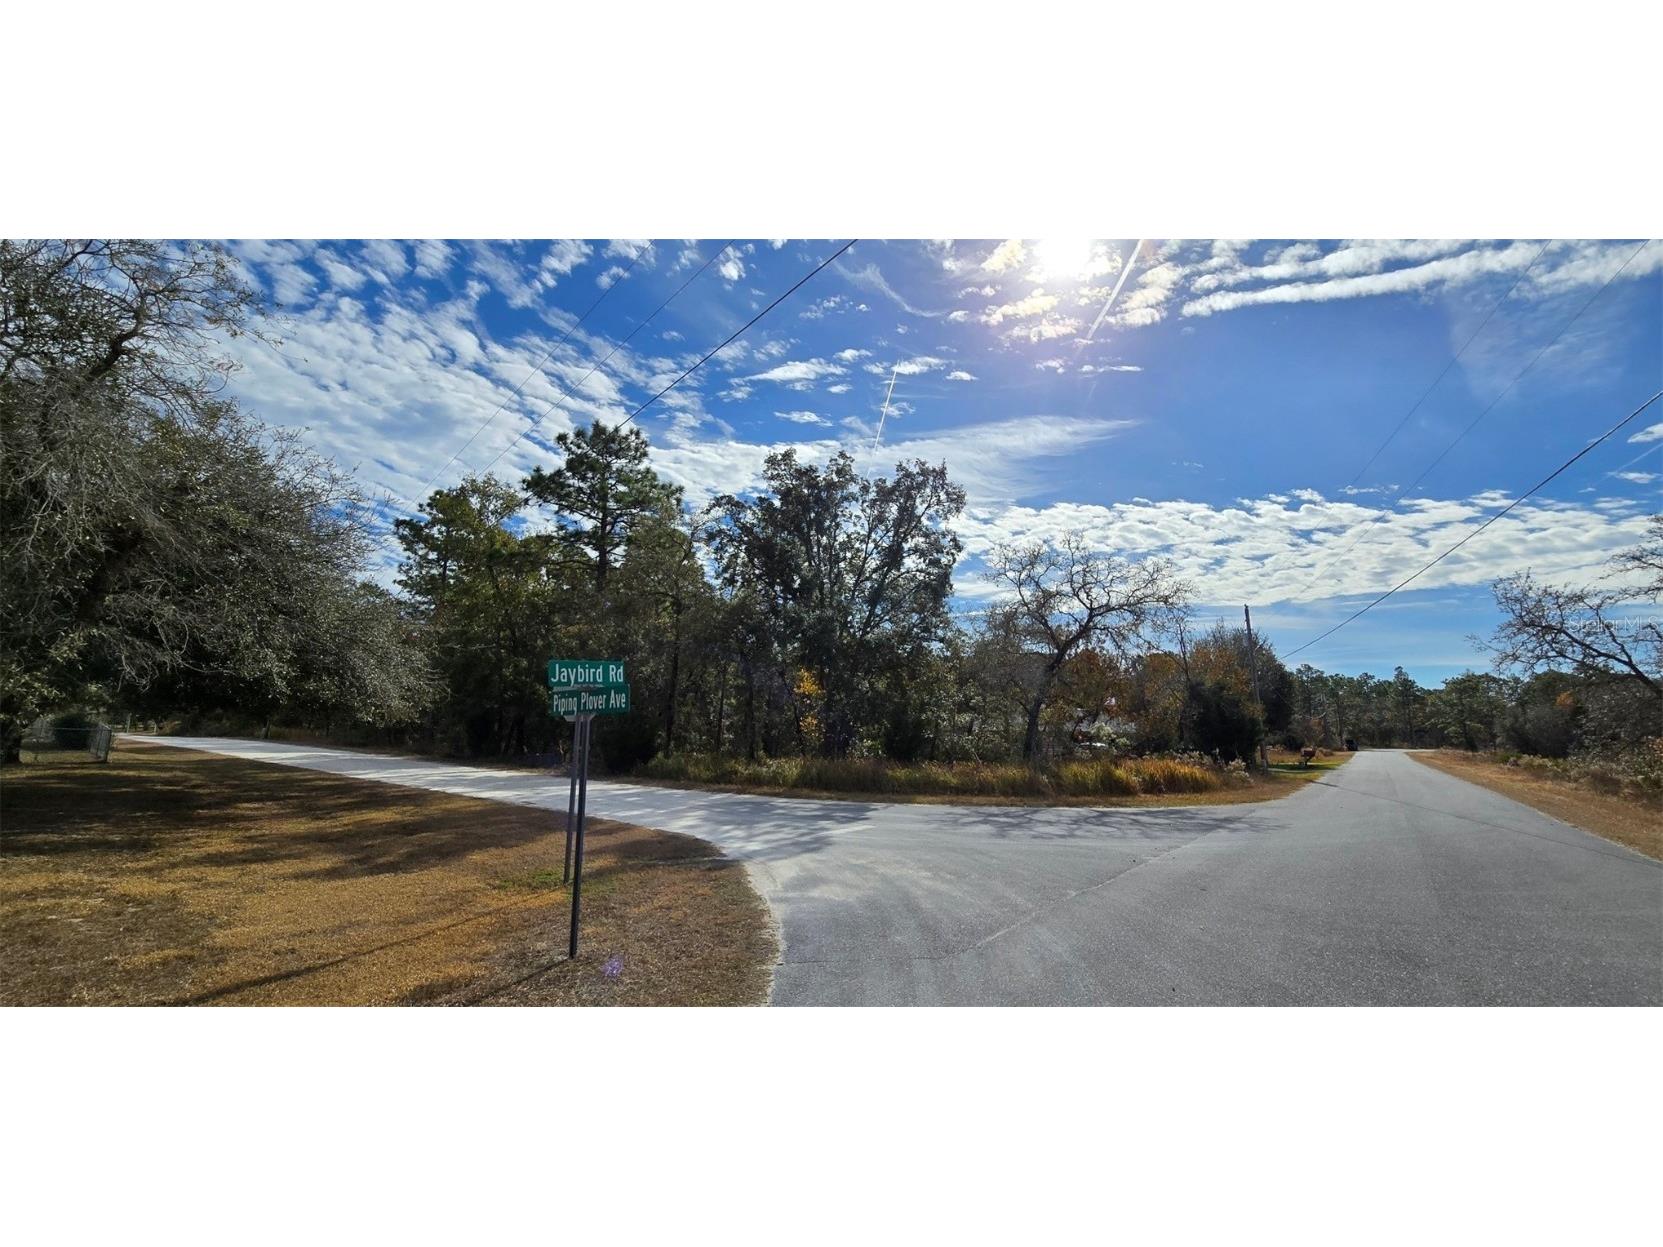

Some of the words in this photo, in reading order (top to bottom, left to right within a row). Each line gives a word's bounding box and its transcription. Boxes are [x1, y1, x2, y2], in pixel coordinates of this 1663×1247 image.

[551, 663, 603, 687] Jaybird
[609, 664, 624, 682] Rd
[553, 694, 577, 715] Piping
[581, 692, 607, 710] Plover
[609, 689, 626, 708] Ave
